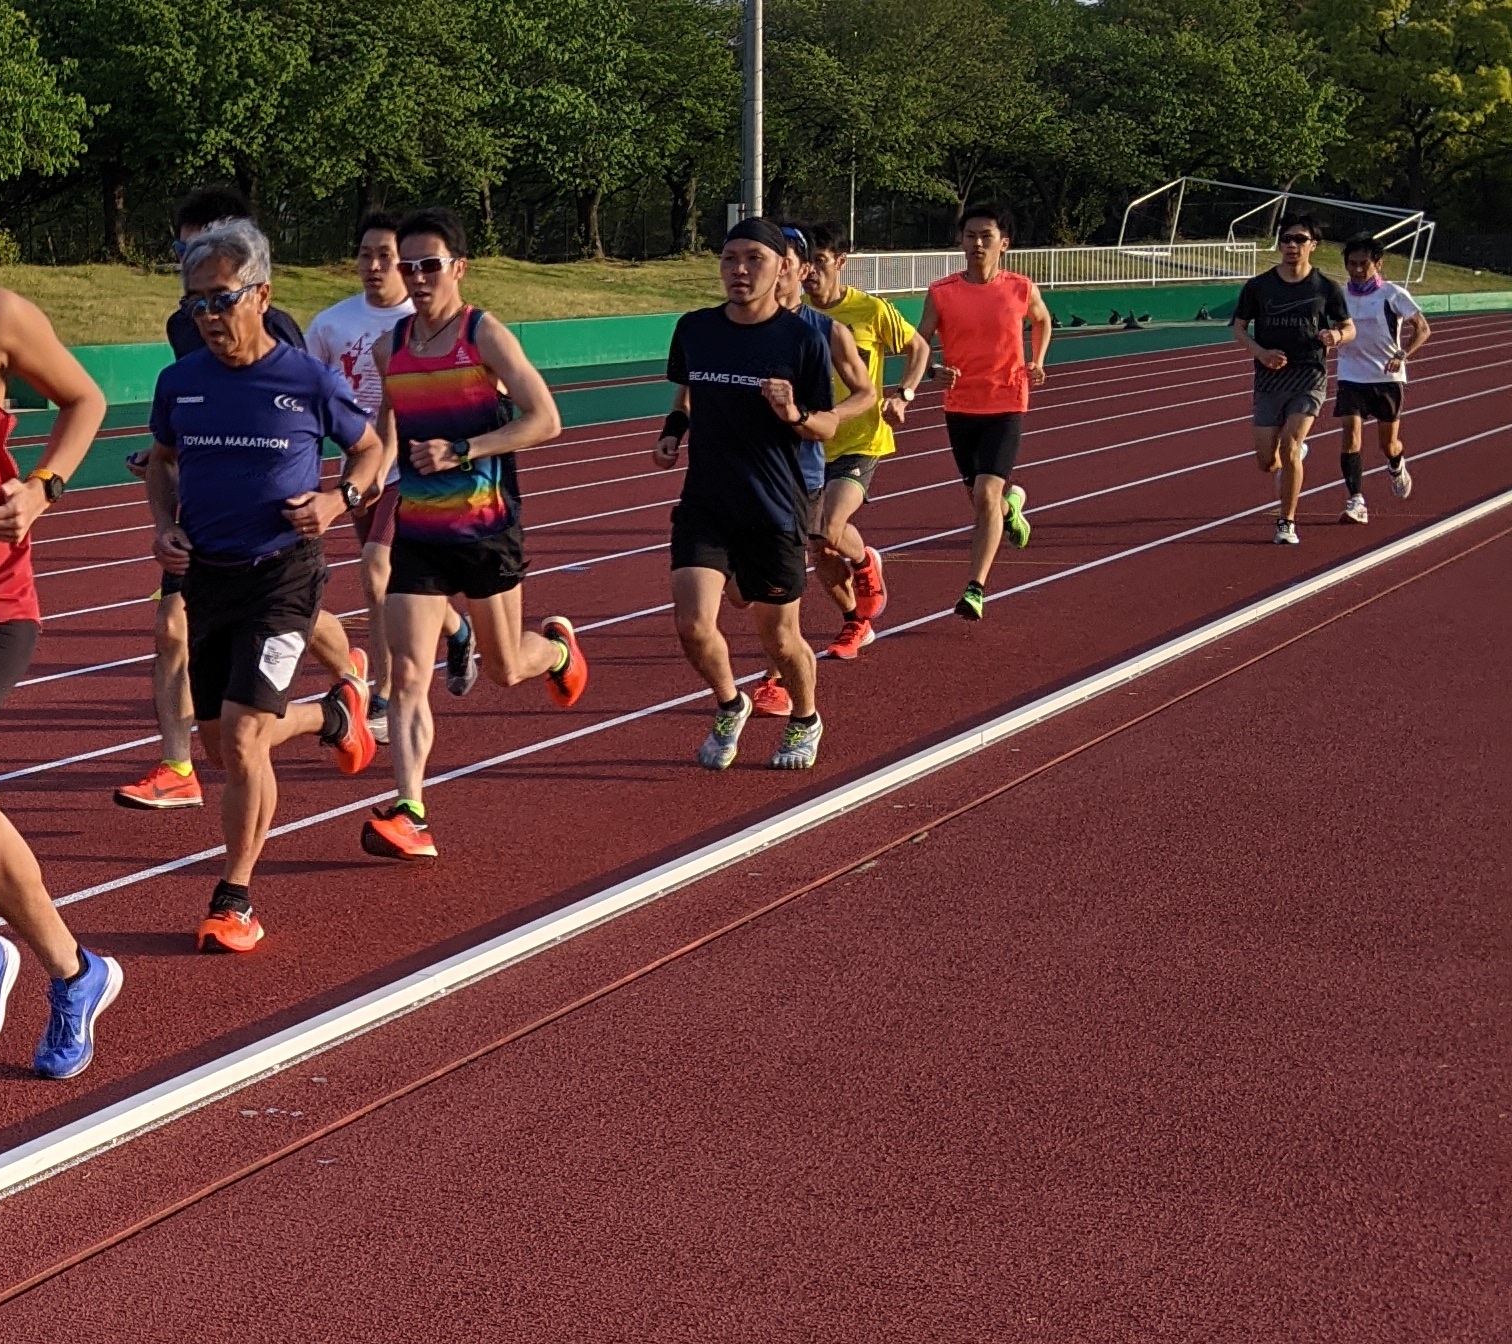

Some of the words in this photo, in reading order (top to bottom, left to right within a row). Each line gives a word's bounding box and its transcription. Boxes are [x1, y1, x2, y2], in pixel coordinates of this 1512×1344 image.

[689, 371, 730, 383] BEAMS
[182, 435, 222, 446] TOYAMA
[224, 436, 289, 450] MARATHON
